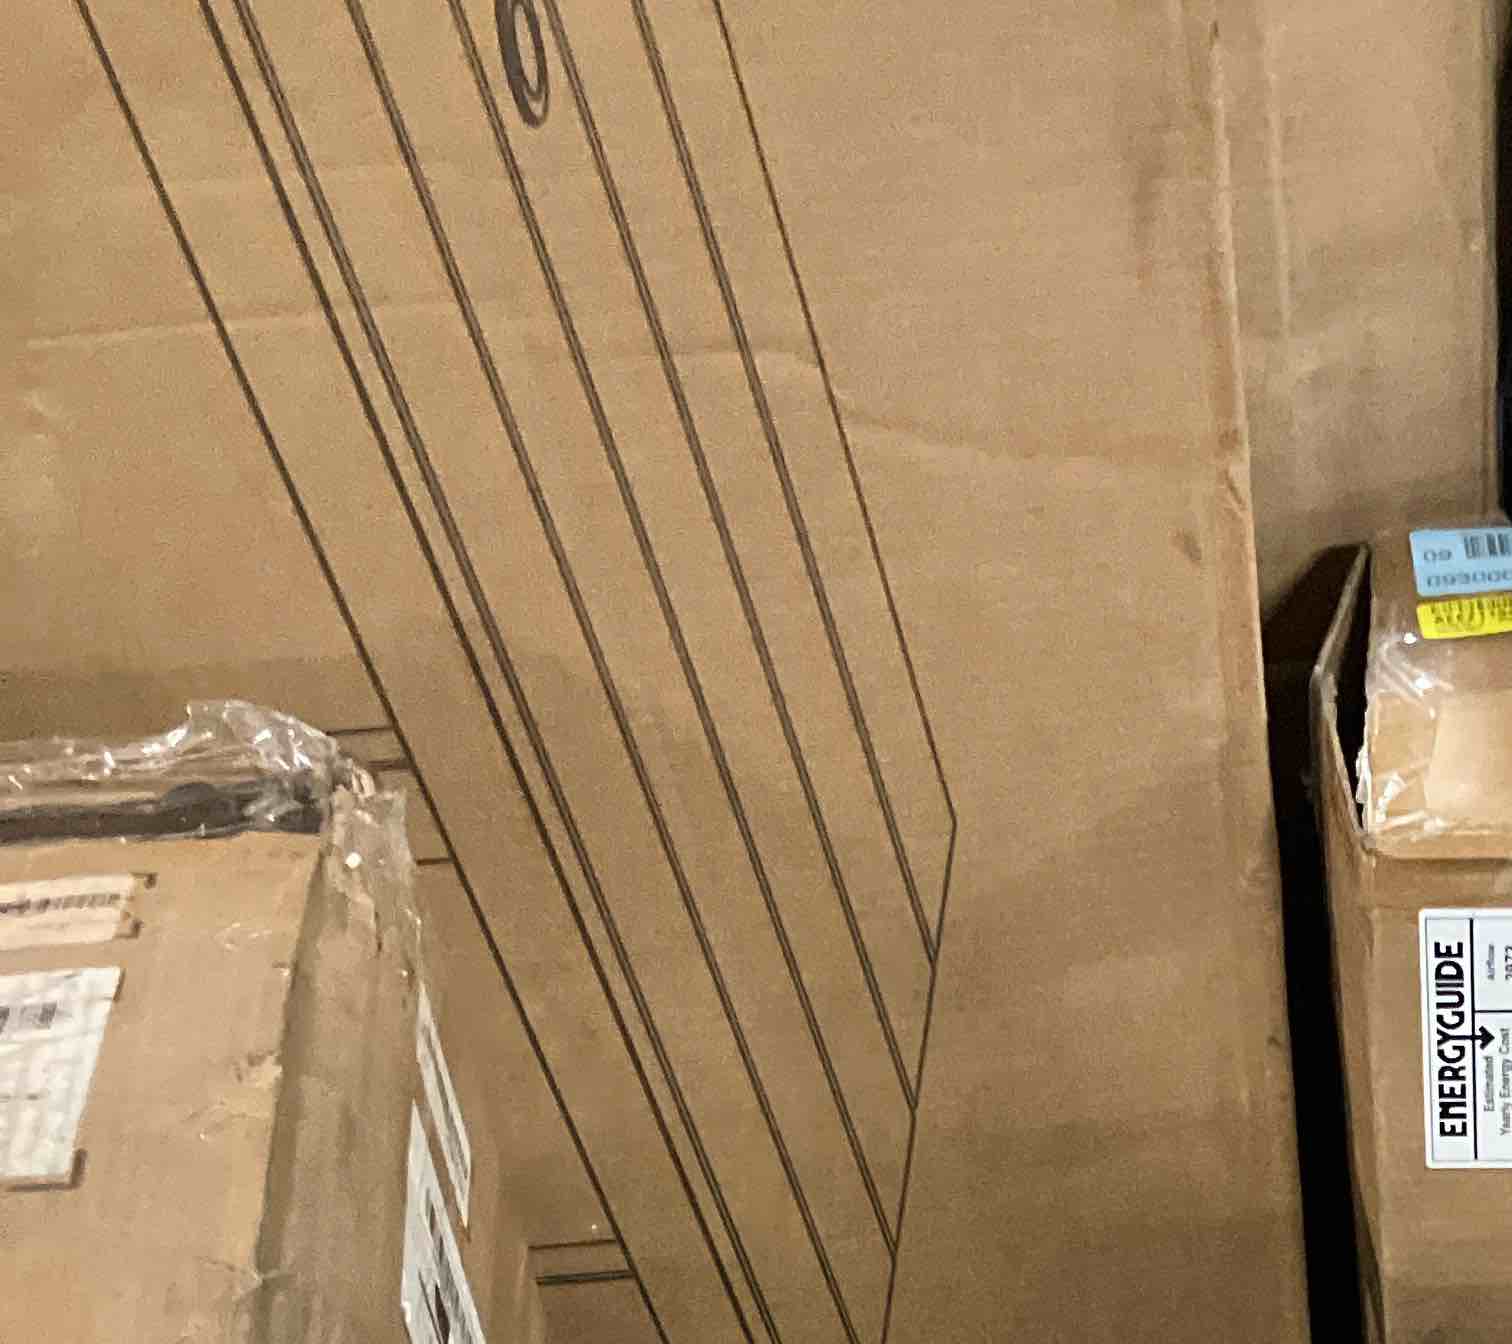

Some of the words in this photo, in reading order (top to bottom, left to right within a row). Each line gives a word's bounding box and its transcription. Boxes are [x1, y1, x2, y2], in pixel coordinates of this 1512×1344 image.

[1434, 941, 1467, 1137] ENERGYGUIDE
[1499, 1027, 1510, 1055] Cost
[1483, 1056, 1494, 1112] Estimated
[1499, 1059, 1512, 1098] Energy
[1499, 1103, 1512, 1135] Yearly
